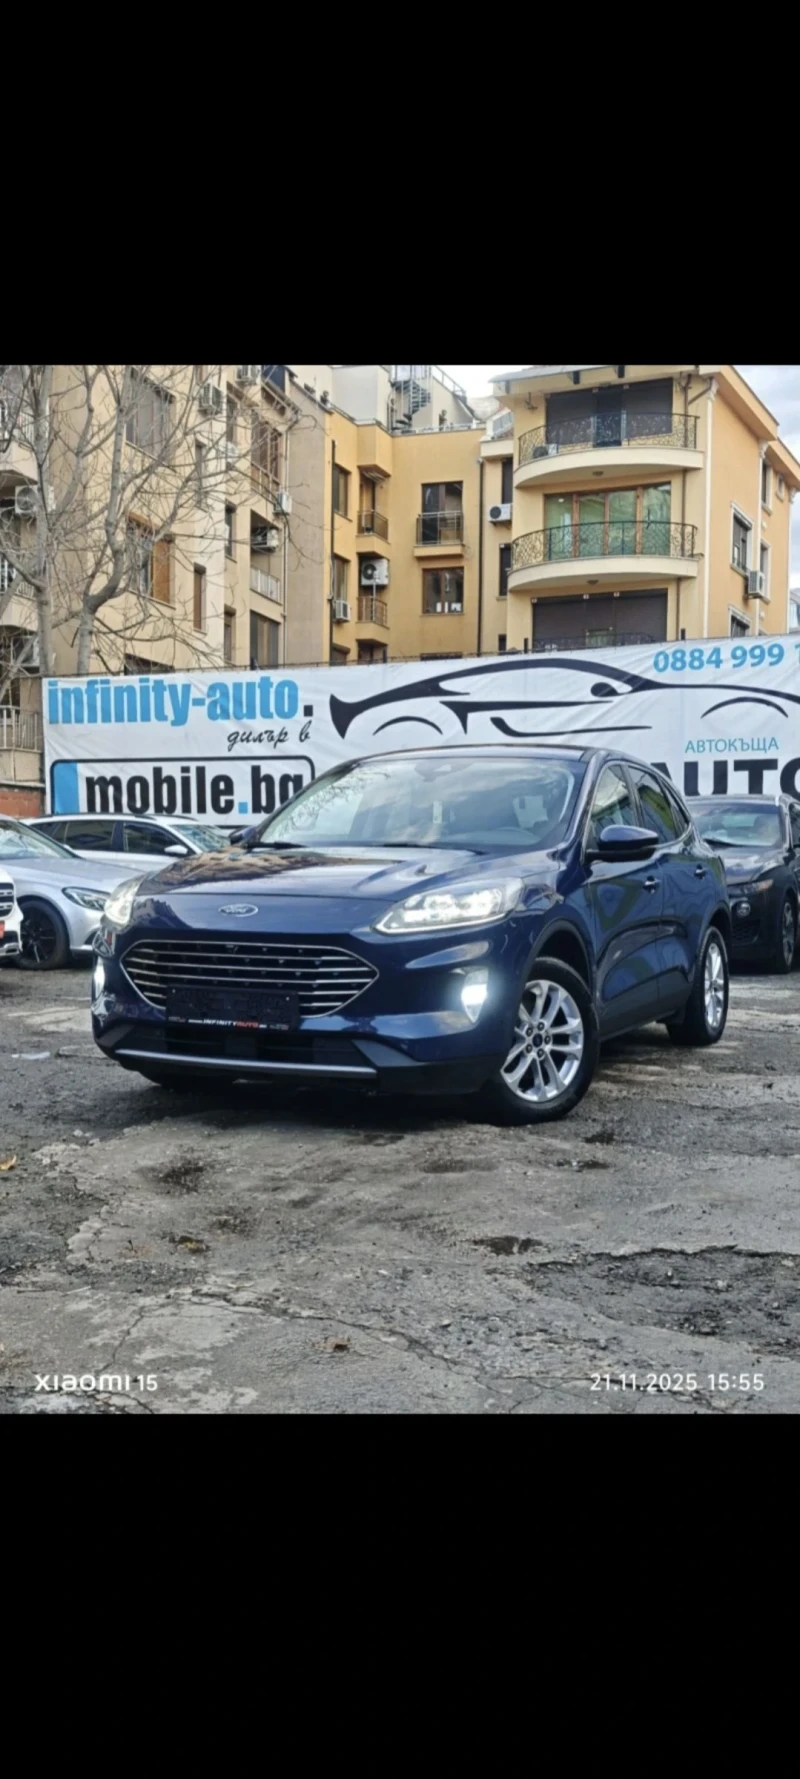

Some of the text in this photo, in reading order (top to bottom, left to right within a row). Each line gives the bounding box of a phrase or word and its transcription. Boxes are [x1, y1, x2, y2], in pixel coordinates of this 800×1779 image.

[653, 647, 723, 673] 0884
[730, 643, 785, 668] 999
[227, 726, 289, 752] дилър
[684, 736, 780, 754] АВТОКЪЩА
